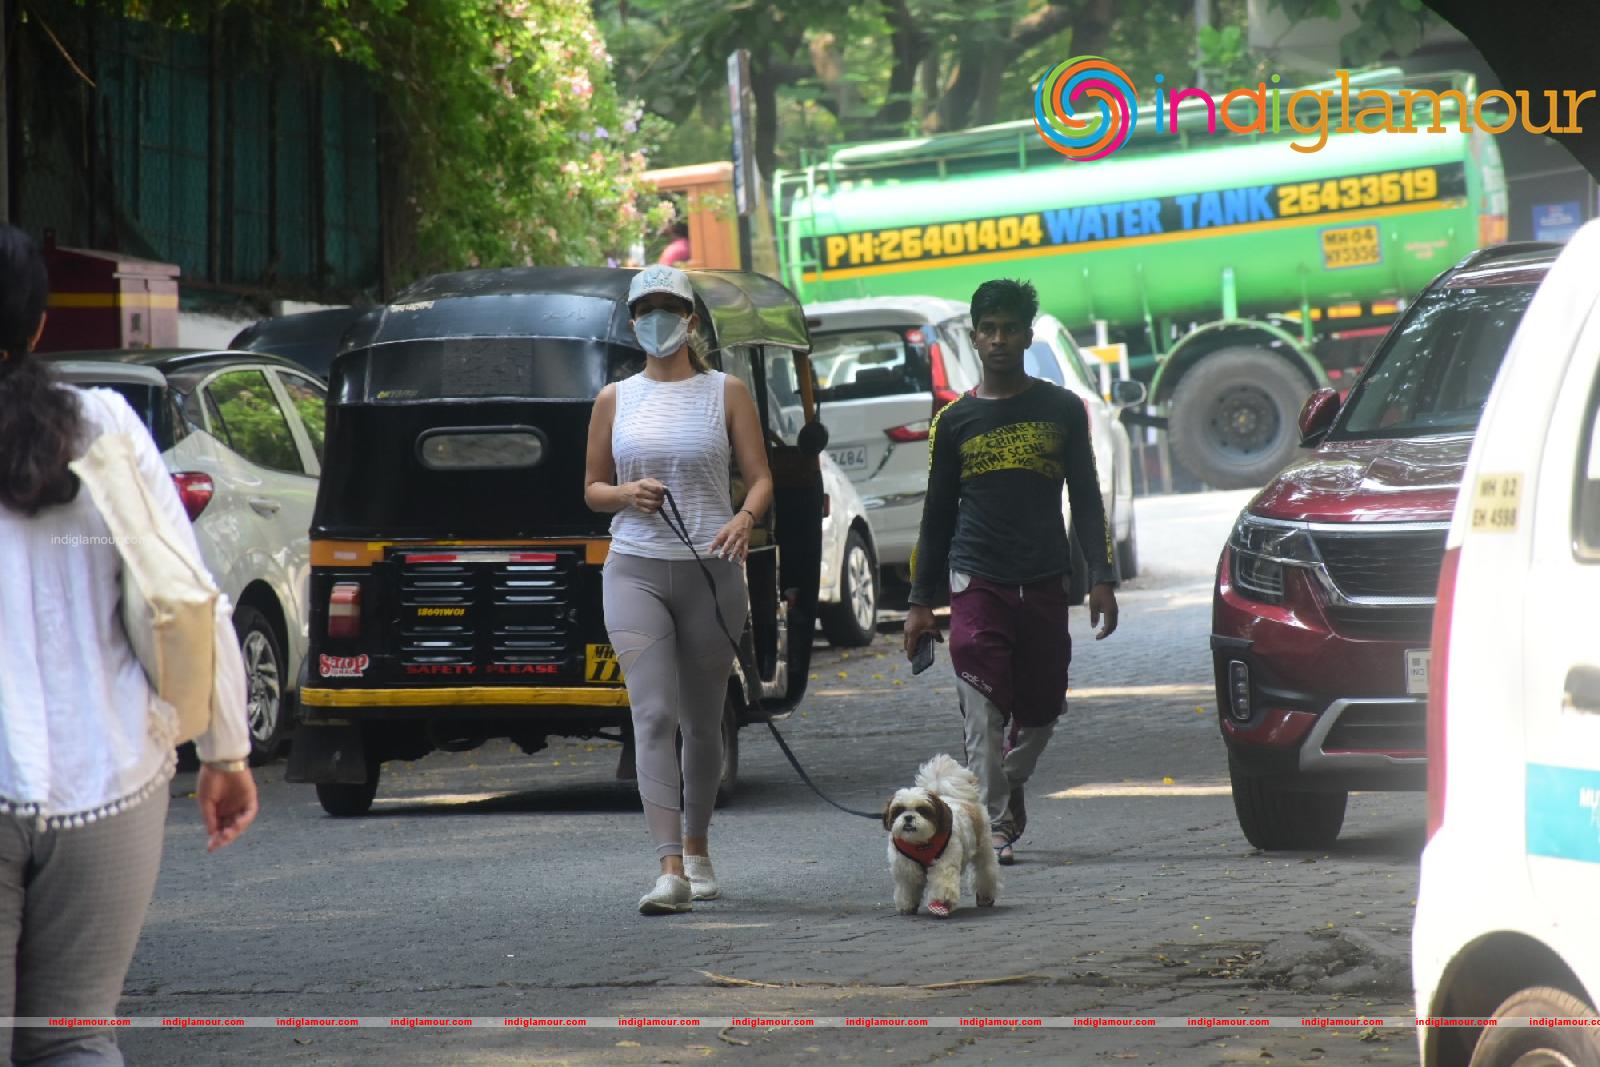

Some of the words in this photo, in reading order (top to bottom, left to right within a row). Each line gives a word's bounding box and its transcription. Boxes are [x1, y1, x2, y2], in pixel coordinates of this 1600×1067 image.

[826, 214, 1042, 267] PH:26401404
[1042, 199, 1163, 244] WATER
[1175, 184, 1275, 231] TANK
[1277, 167, 1437, 216] 26433619
[406, 664, 477, 674] SAFETY
[485, 664, 559, 674] PLEASE
